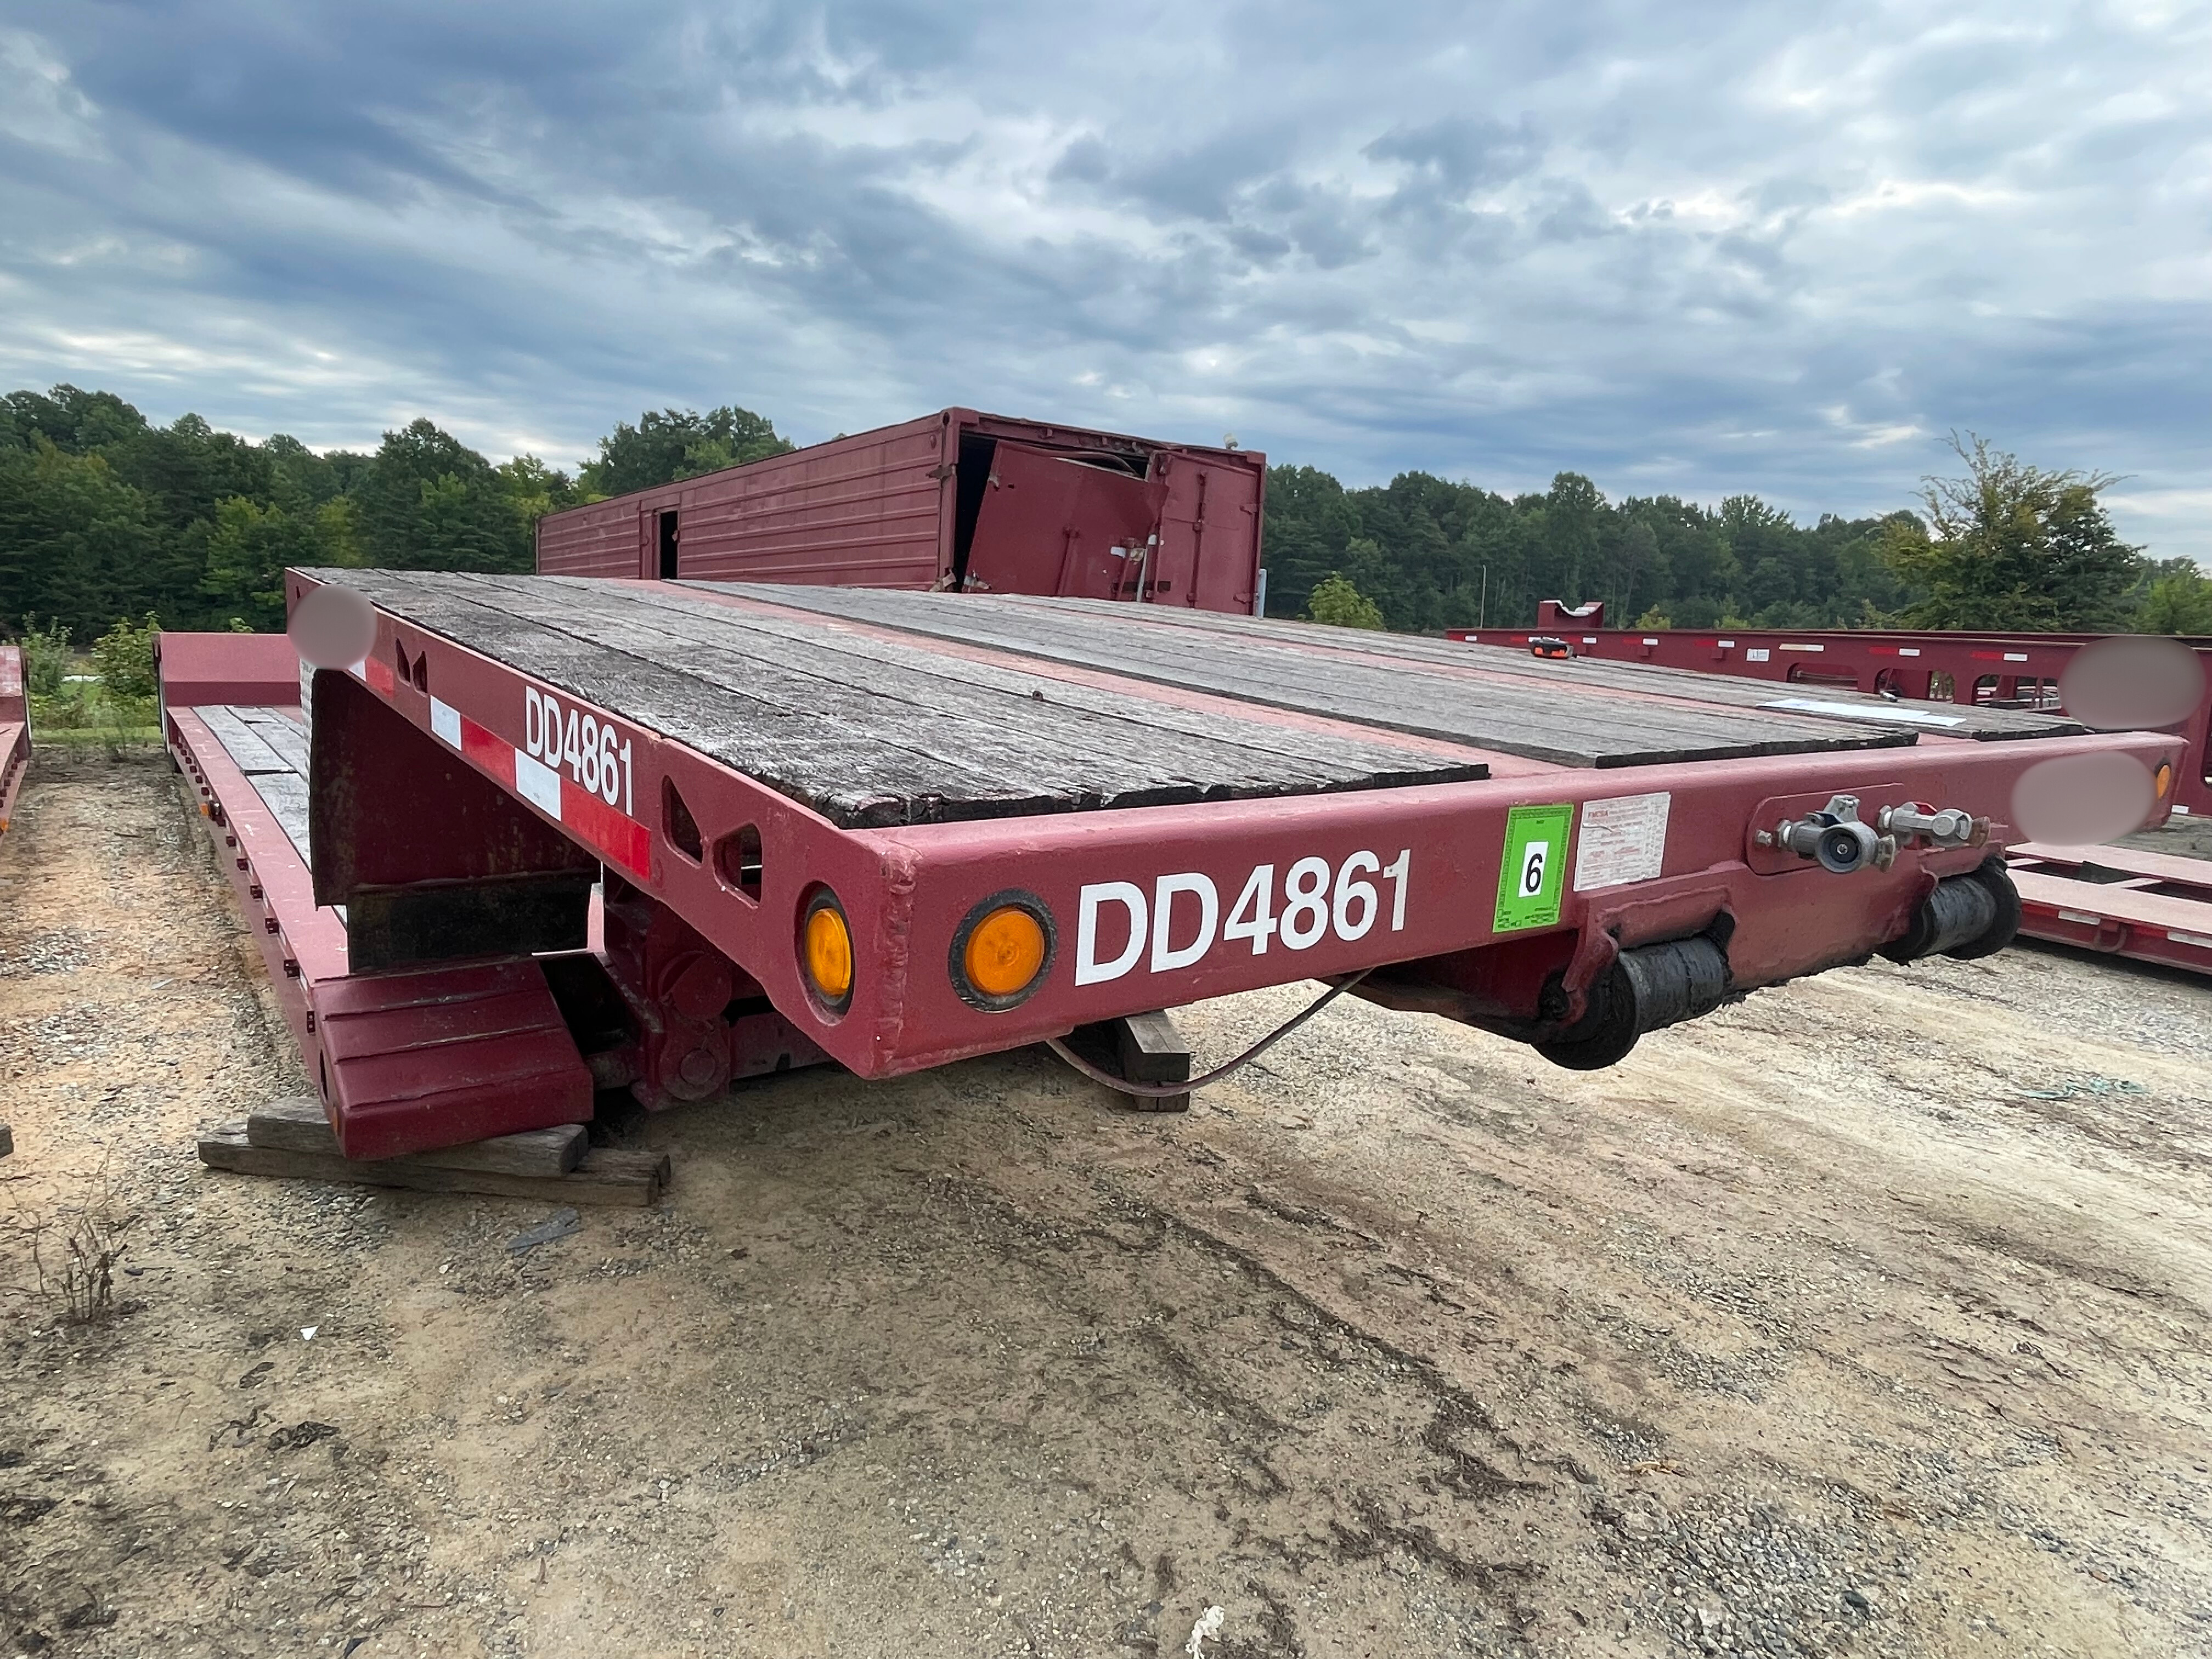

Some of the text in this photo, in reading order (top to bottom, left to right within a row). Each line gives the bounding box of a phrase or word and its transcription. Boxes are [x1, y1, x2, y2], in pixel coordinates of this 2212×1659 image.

[525, 686, 633, 817] DD4861
[1075, 849, 1411, 986] DD4861
[1526, 854, 1543, 893] 6
